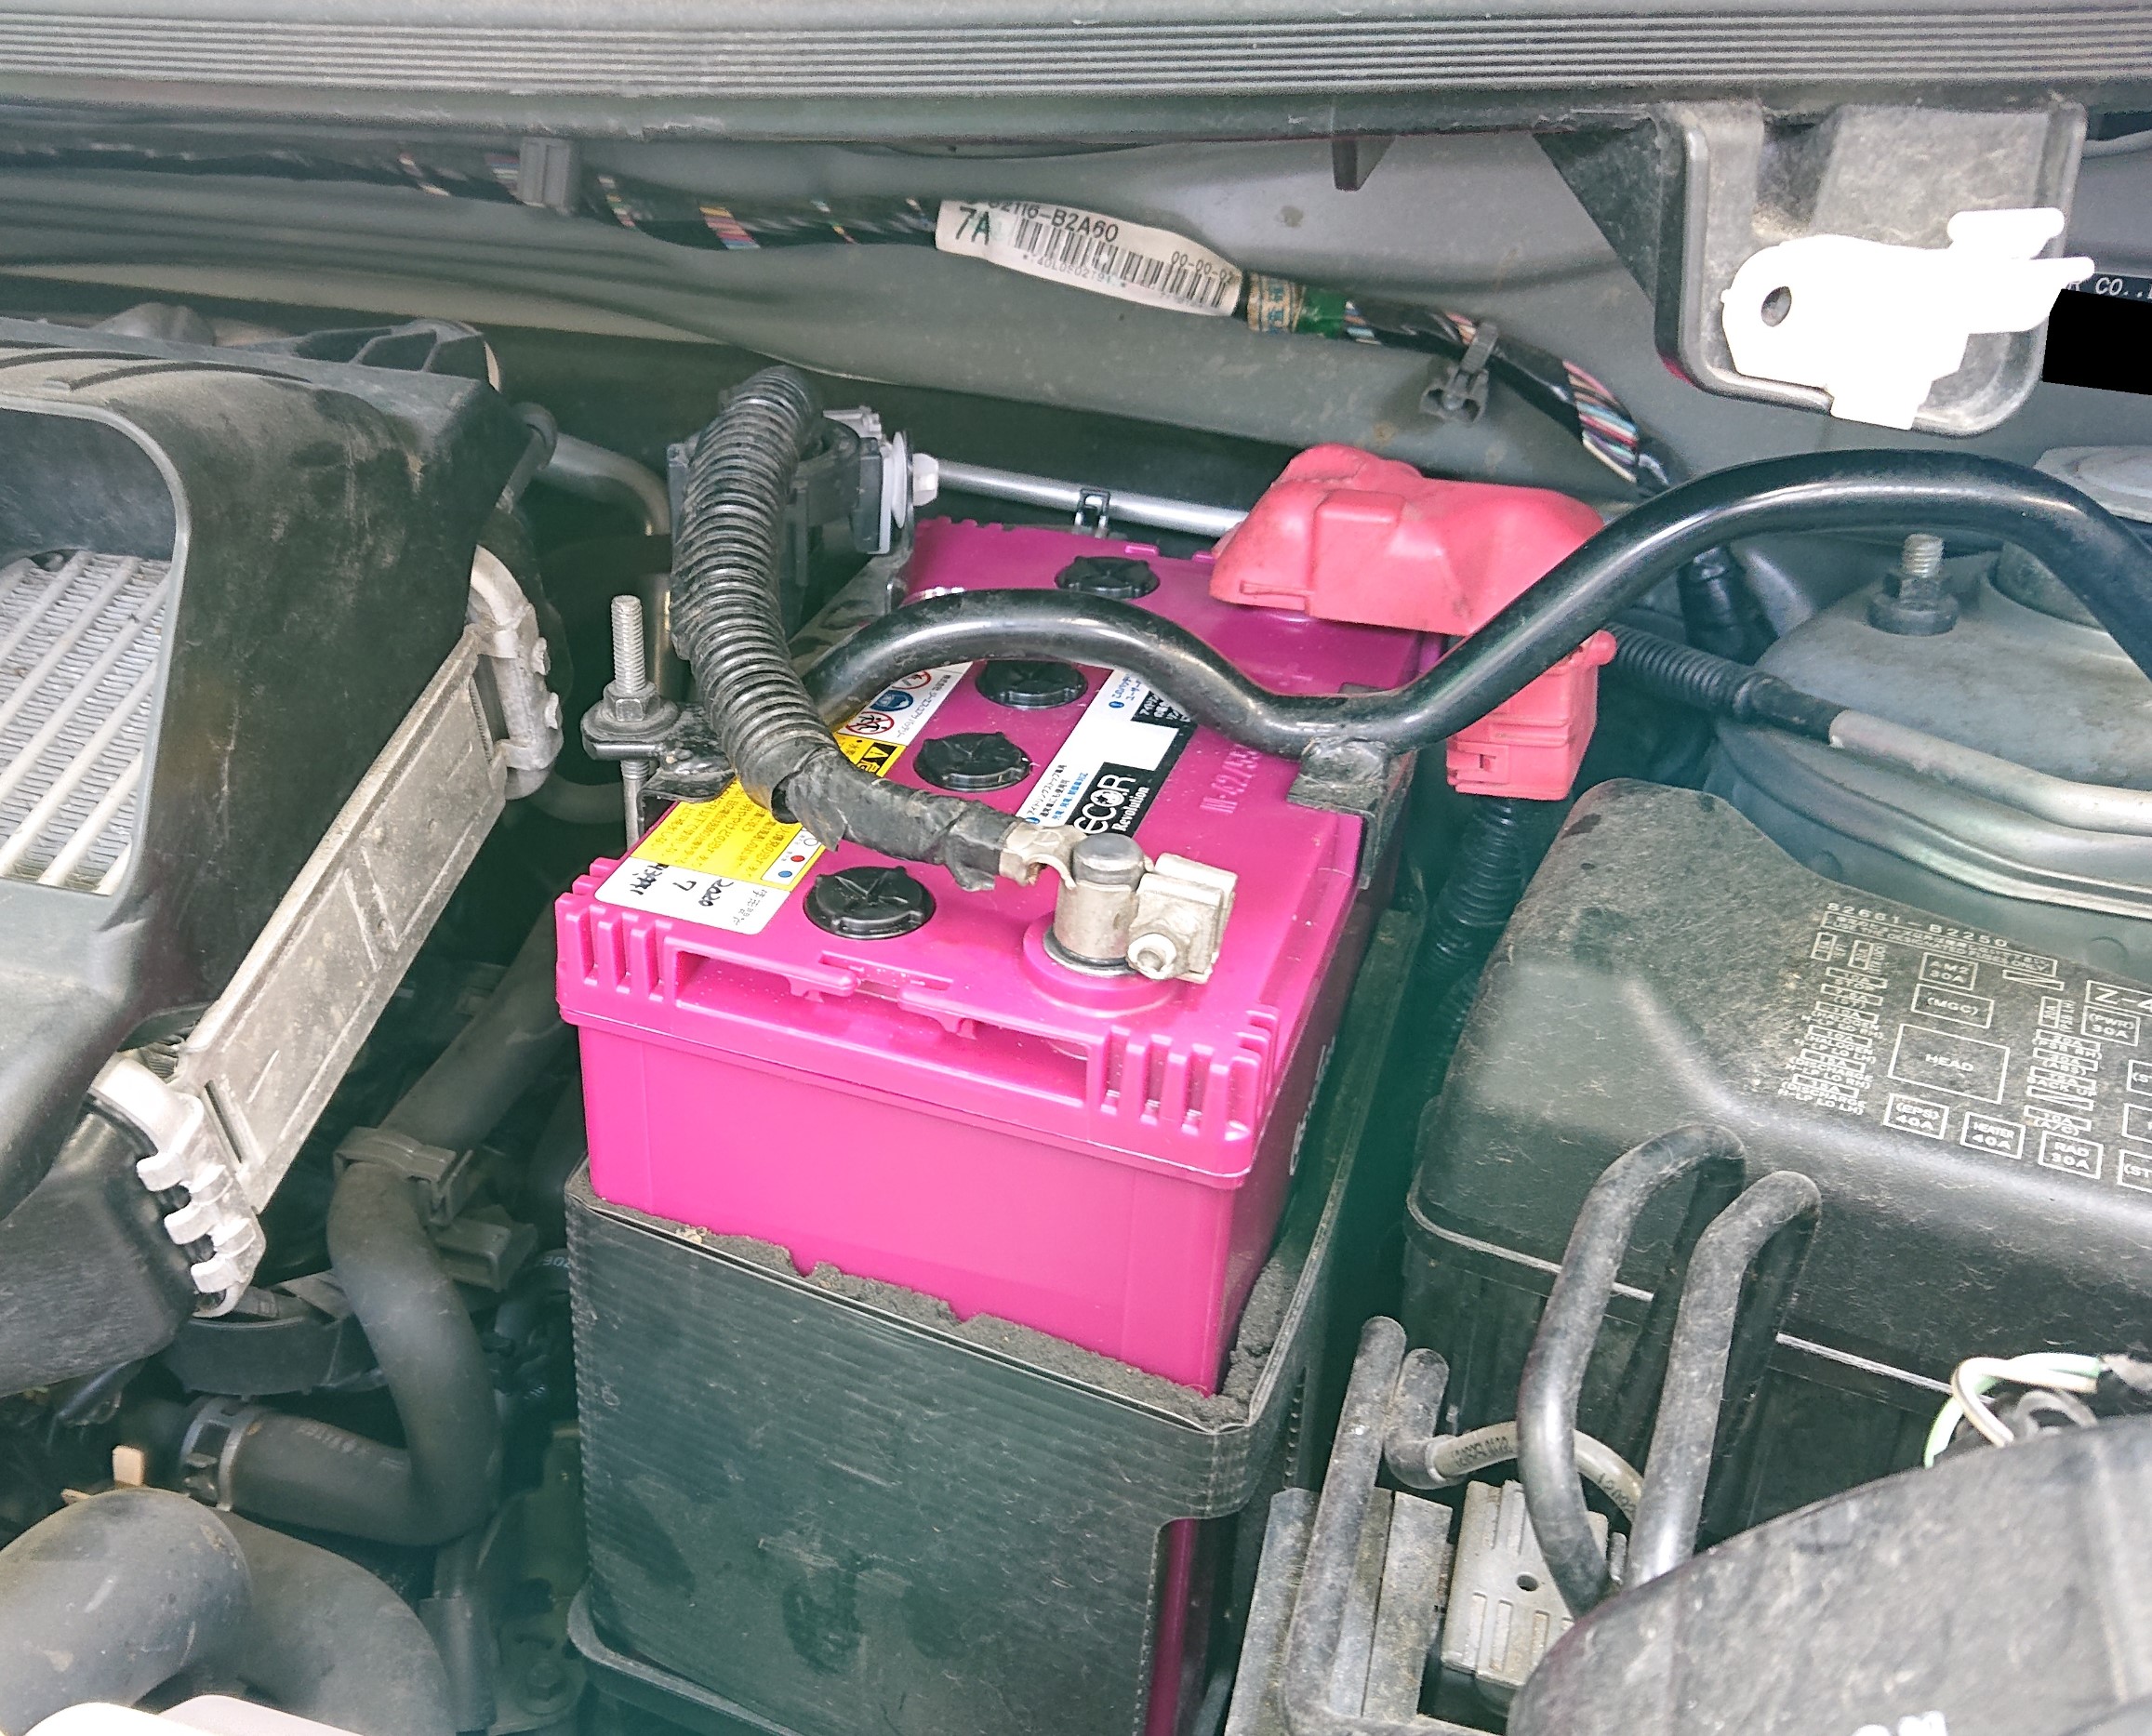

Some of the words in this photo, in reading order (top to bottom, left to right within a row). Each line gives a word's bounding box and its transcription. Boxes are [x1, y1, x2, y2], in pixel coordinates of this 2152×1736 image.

[959, 205, 991, 245] 7A
[1111, 786, 1152, 833] Revolution
[697, 878, 736, 908] 2020
[1927, 997, 1979, 1016] (MGC)
[2089, 1013, 2135, 1030] (PWR)
[1925, 1053, 1974, 1073] HEAD
[2042, 1059, 2087, 1076] (ABS)
[2026, 1075, 2069, 1093] BACK
[2076, 1087, 2097, 1097] UP
[2132, 1071, 2152, 1083] (S
[1895, 1101, 1941, 1120] (EPS)
[1895, 1114, 1934, 1132] 40A
[1973, 1120, 2016, 1140] HEATER
[2033, 1119, 2080, 1136] (A/C)
[1972, 1133, 2012, 1151] 40A
[2054, 1141, 2090, 1158] RAD
[2052, 1152, 2090, 1171] 30A
